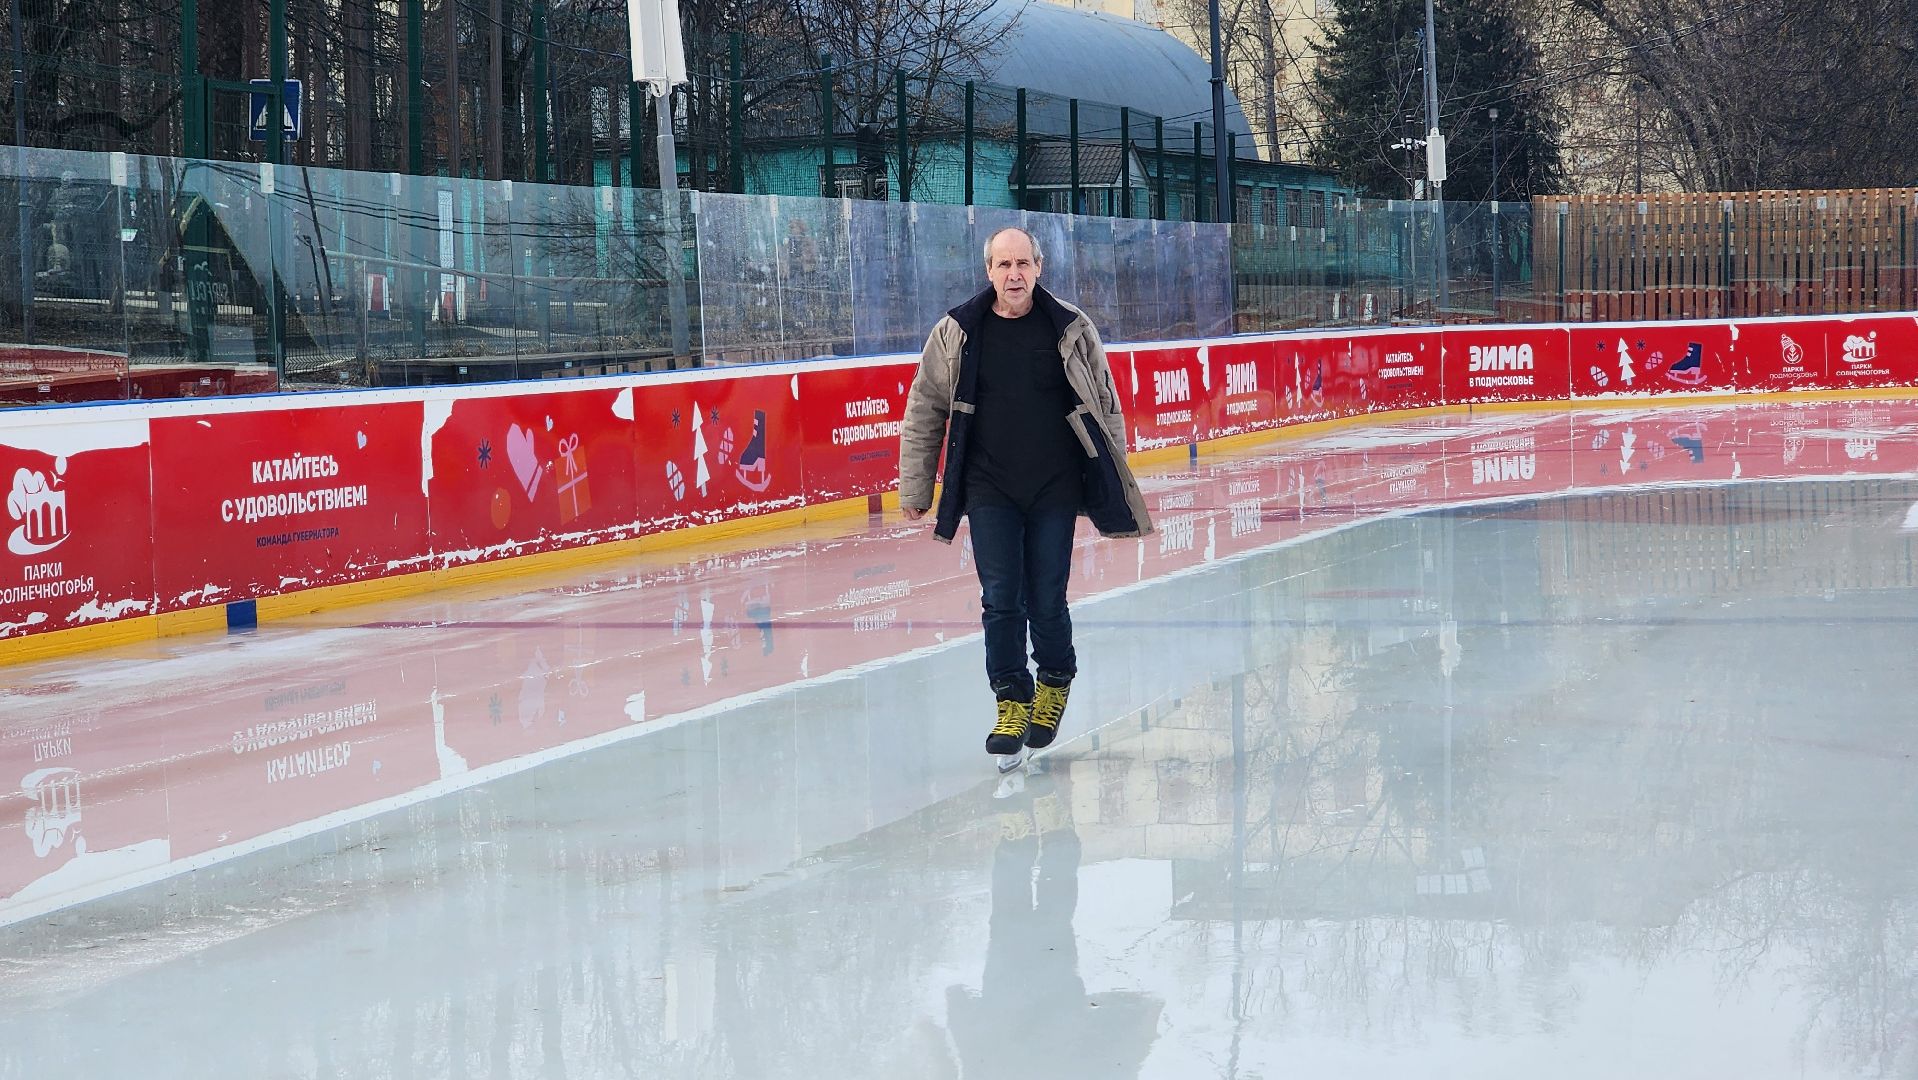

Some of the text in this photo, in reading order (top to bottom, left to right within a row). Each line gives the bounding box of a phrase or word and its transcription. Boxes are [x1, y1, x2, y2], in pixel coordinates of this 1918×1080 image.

[1385, 351, 1414, 364] КАТАЙТЕСЬ
[1469, 343, 1534, 371] ЗИМА
[1225, 361, 1258, 396] ЗИМА
[1469, 375, 1534, 388] В ПОДМОСКОВЬЕ
[1769, 372, 1818, 380] ПОДМОСКОВЬЯ
[1836, 369, 1890, 377] СОЛНЕЧНОГОРЬЯ
[1153, 367, 1191, 406] ЗИМА
[845, 396, 890, 418] КАТАЙТЕСЬ
[832, 428, 839, 445] С
[252, 452, 339, 483] КАТАЙТЕСЬ
[221, 484, 368, 524] С УДОВОЛЬСТВИЕМ!
[256, 527, 340, 548] КОМАНДА ГУБЕРНАТОРА
[24, 561, 63, 581] ПАРКИ
